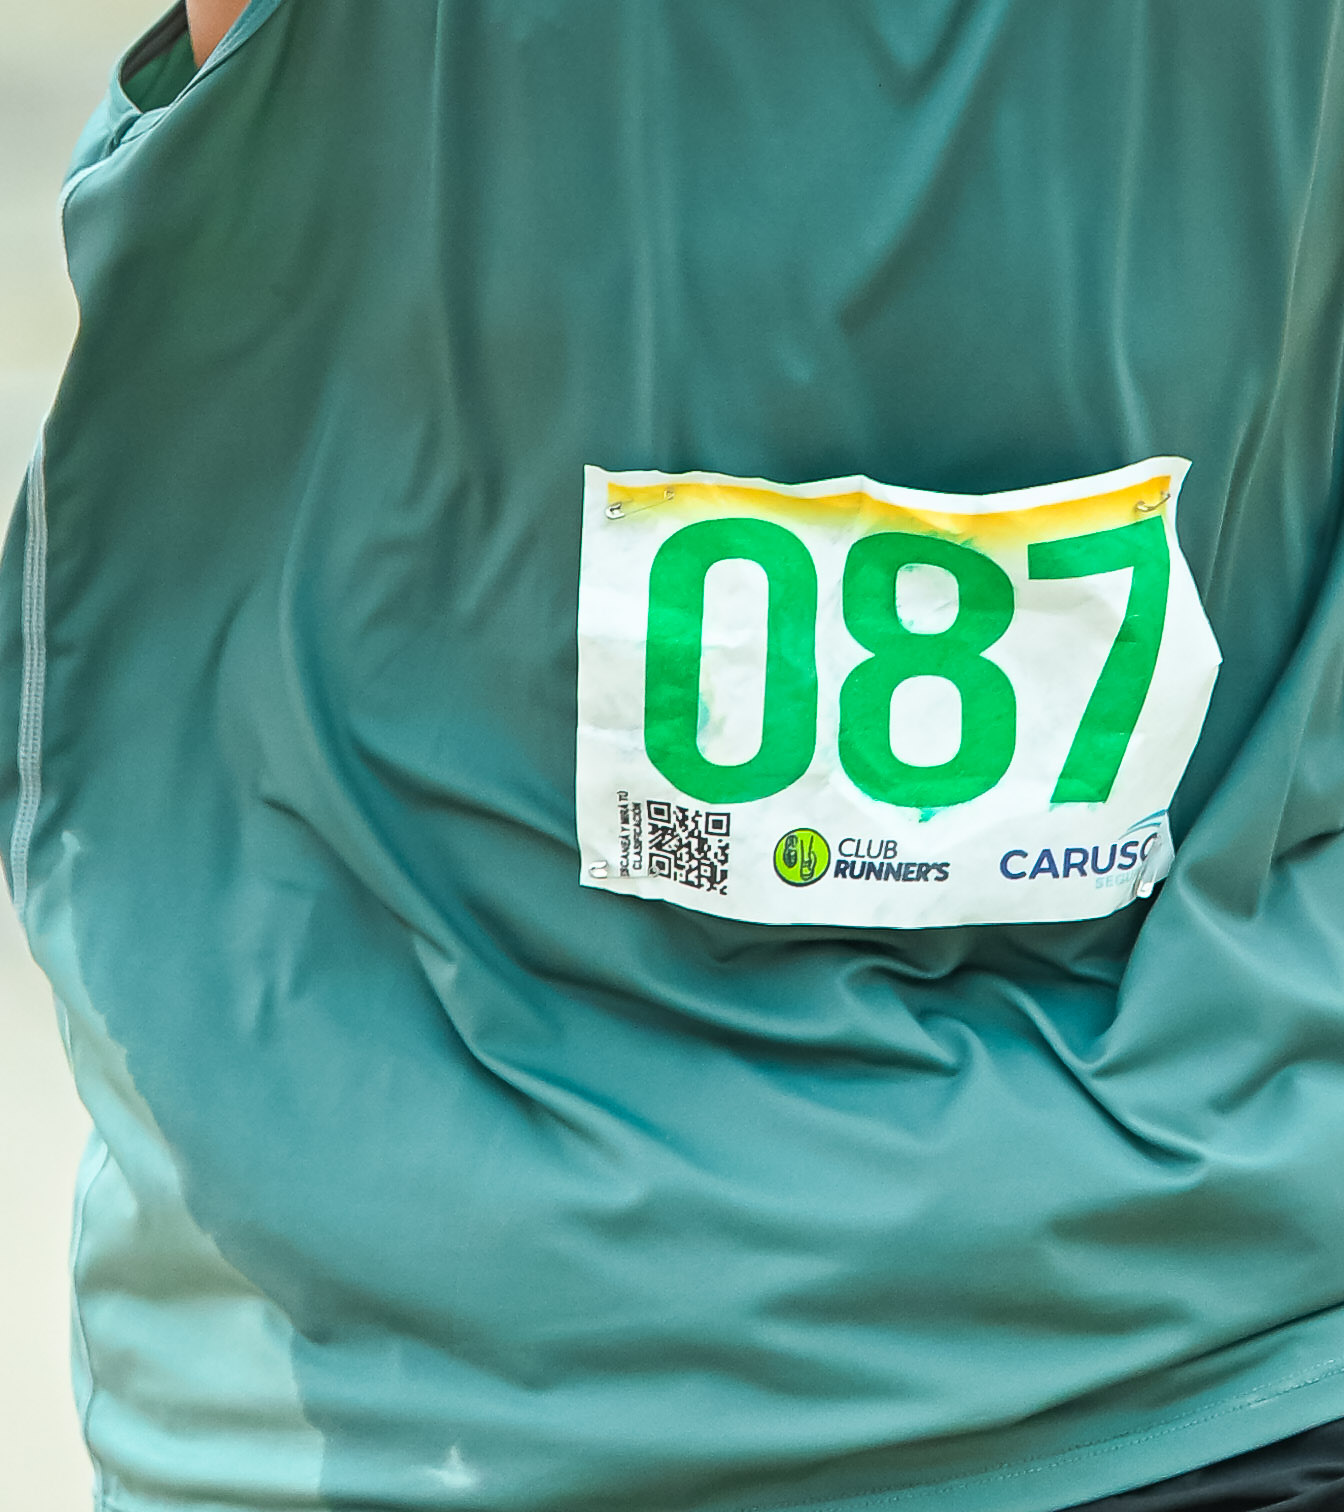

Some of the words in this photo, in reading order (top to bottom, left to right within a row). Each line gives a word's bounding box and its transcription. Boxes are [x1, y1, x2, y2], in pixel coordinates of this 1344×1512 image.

[644, 516, 1171, 807] 087
[838, 837, 898, 859] CLUB
[833, 859, 950, 882] RUNNER'S
